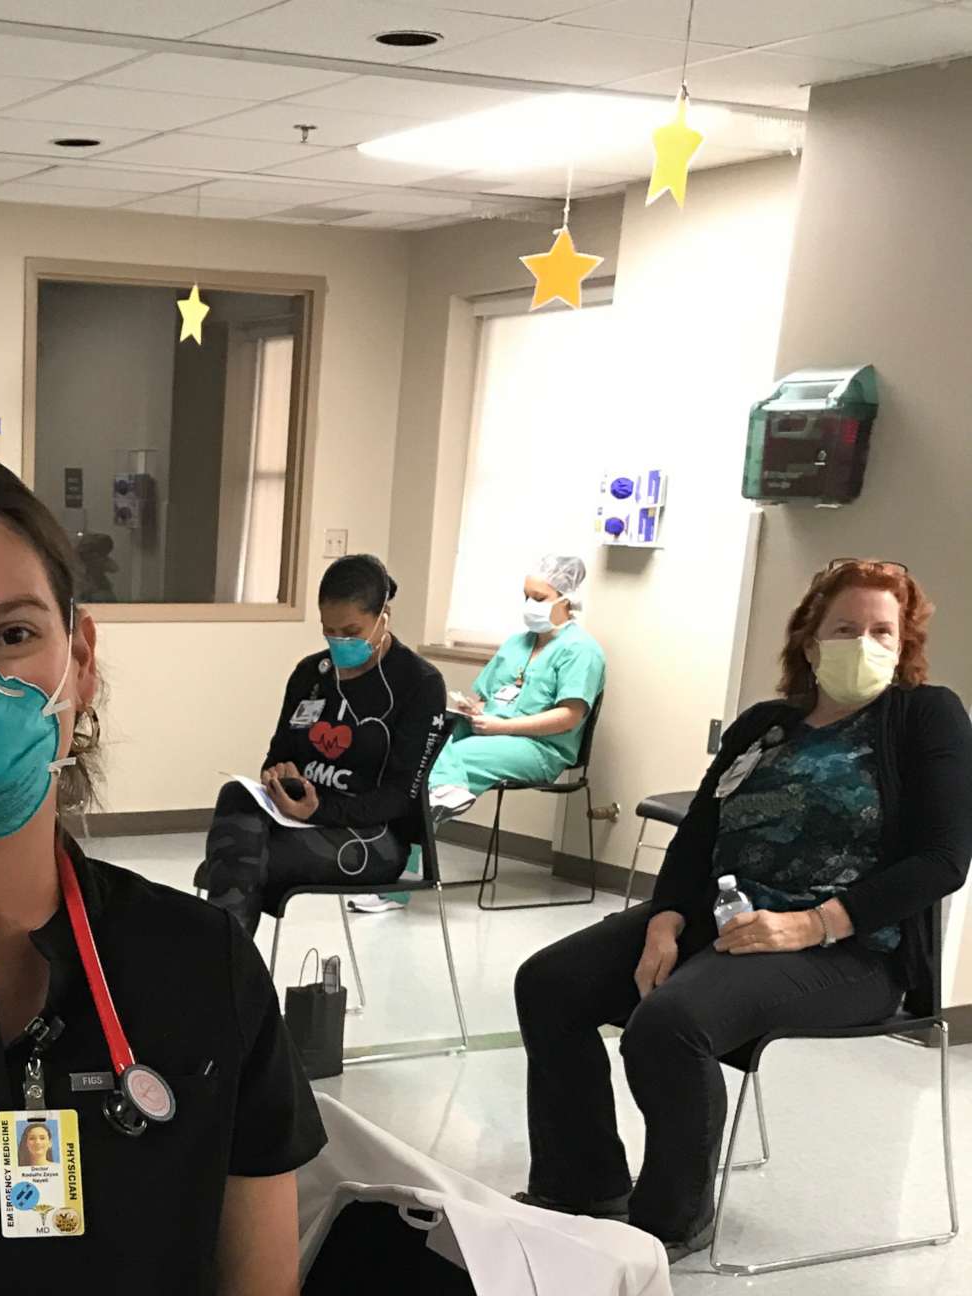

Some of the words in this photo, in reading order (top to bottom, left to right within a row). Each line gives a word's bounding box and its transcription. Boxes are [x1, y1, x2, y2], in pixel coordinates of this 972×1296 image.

[304, 760, 354, 791] BMC
[82, 1075, 104, 1086] FIGS
[1, 1119, 13, 1166] MEDICINE
[66, 1142, 78, 1201] PHYSICIAN
[4, 1169, 15, 1228] EMERGENCY
[36, 1226, 50, 1234] MD
